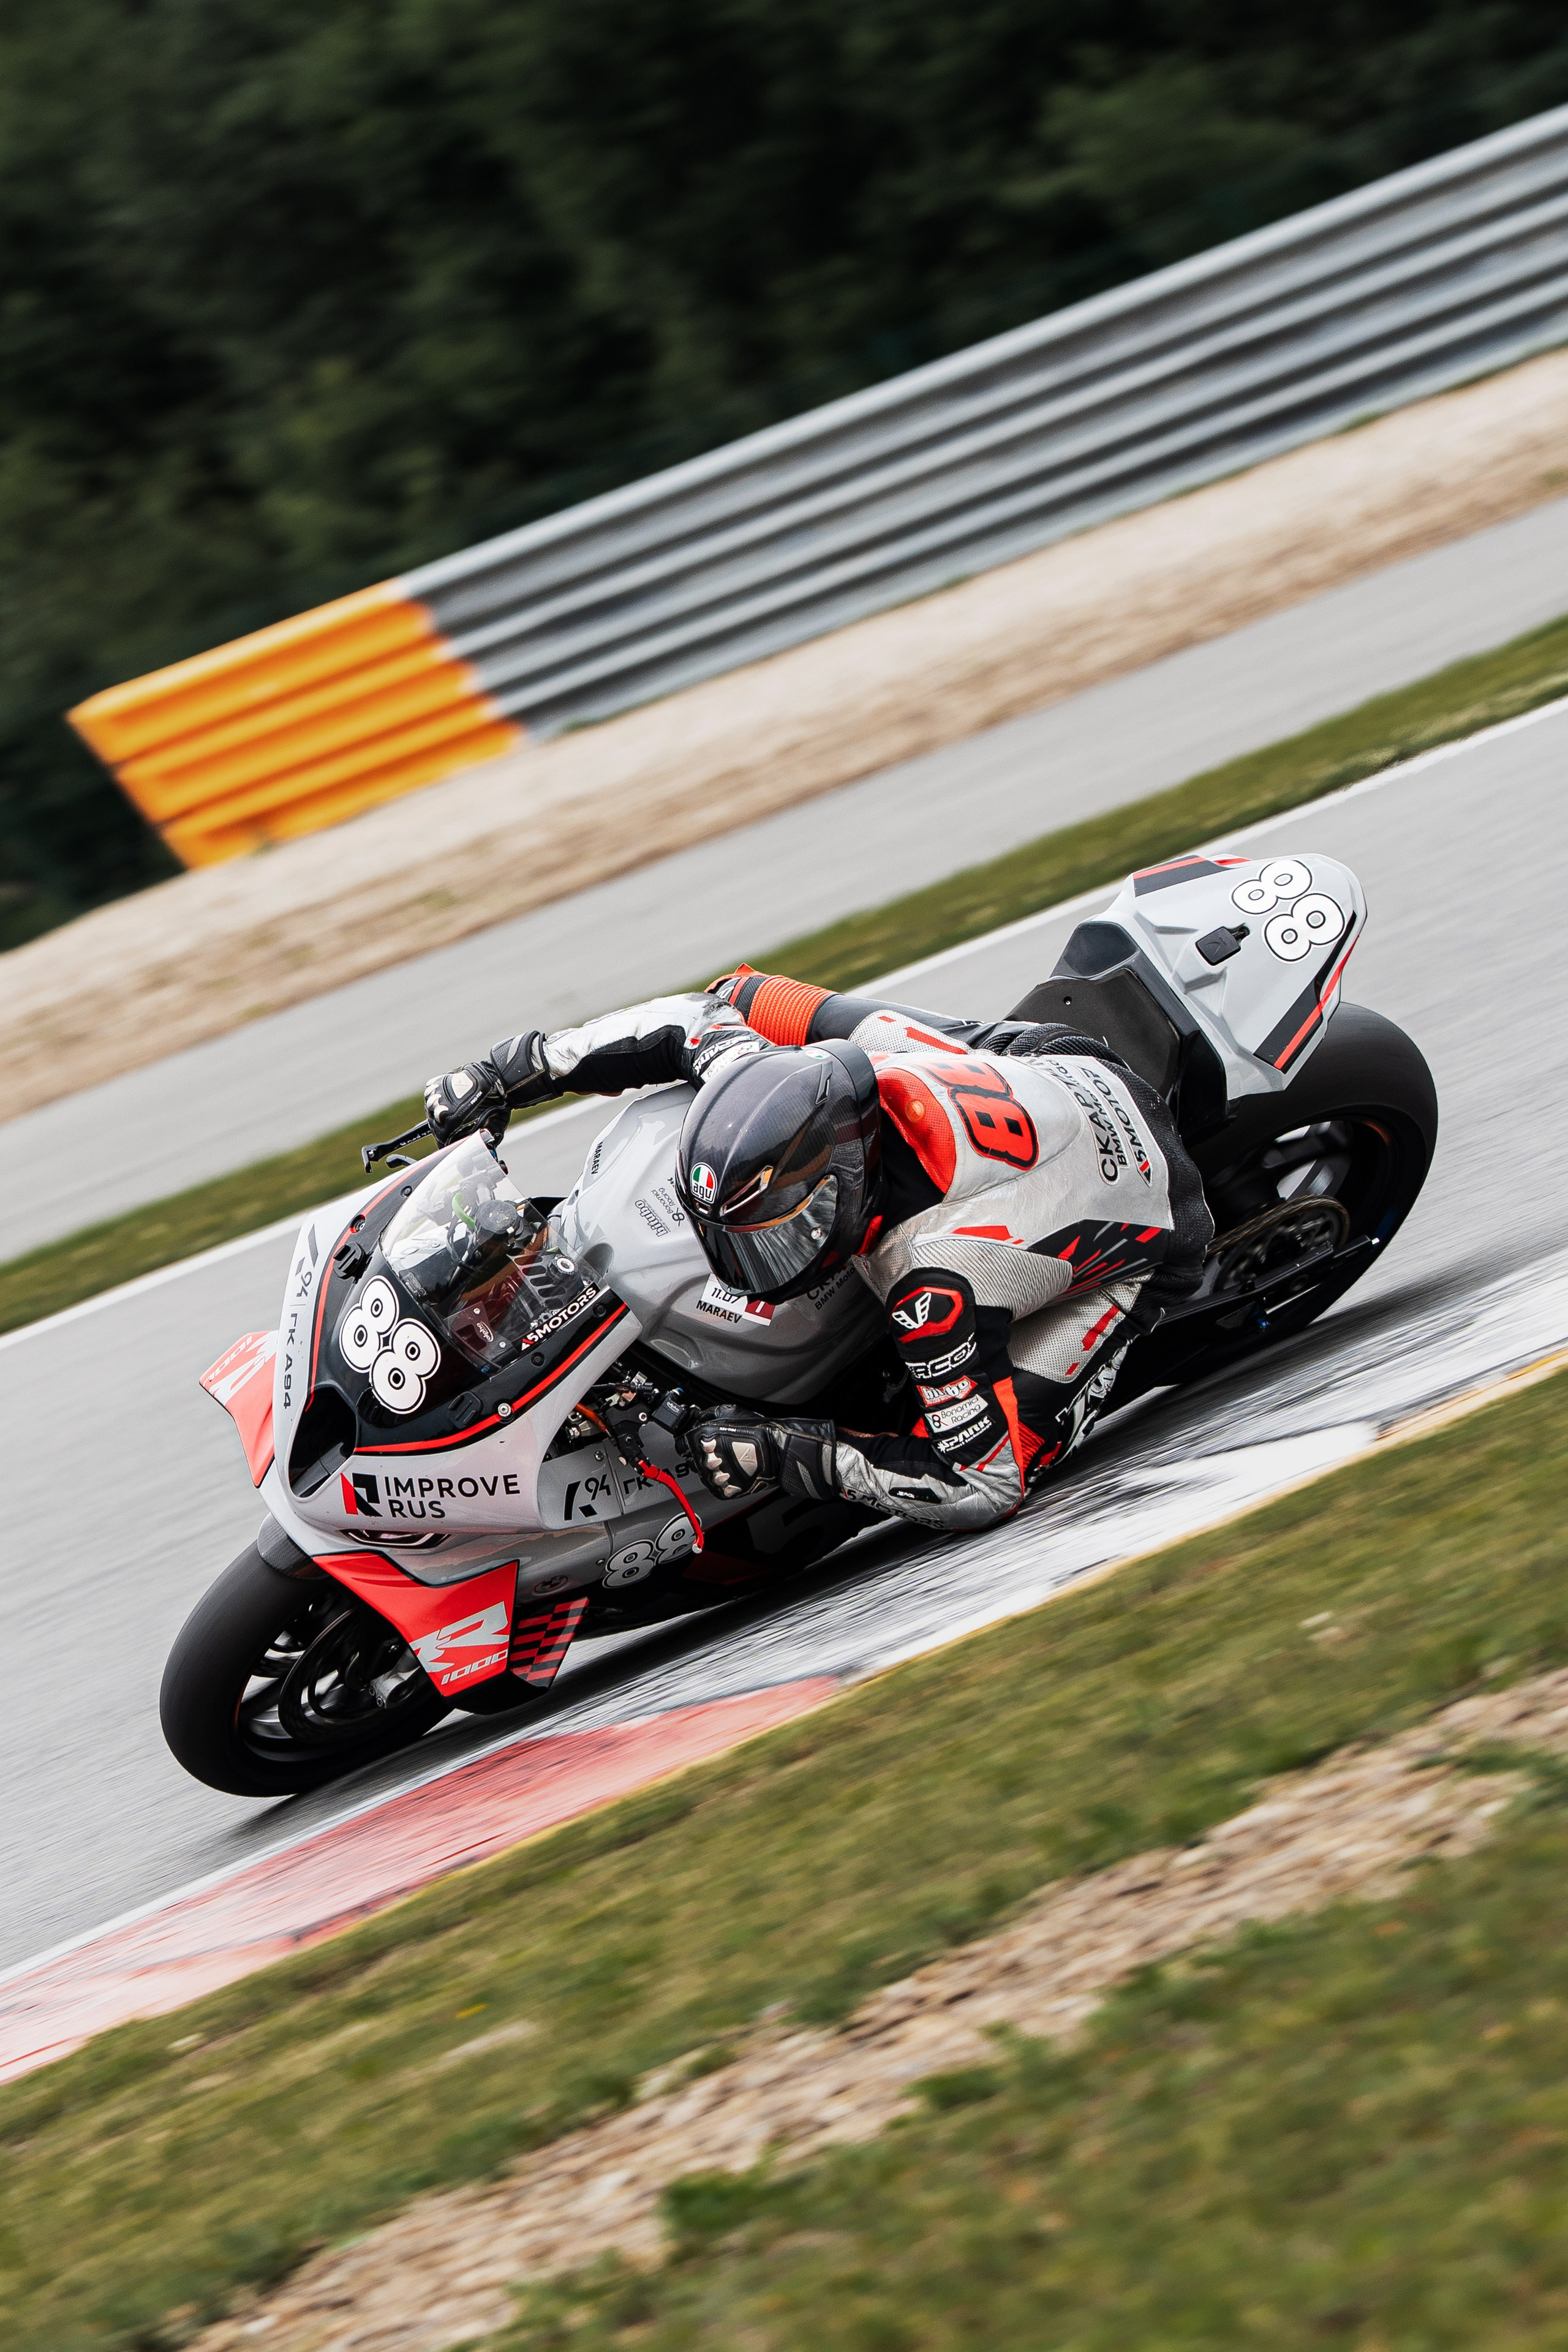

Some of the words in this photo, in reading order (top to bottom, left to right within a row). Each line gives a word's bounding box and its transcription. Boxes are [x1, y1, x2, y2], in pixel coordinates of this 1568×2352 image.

[1231, 859, 1346, 962] 88
[591, 1141, 603, 1175] MARAEV
[1104, 1120, 1128, 1166] BMW
[650, 1189, 674, 1214] Bonamici
[658, 1187, 676, 1207] Racing
[635, 1199, 668, 1237] bitubo
[815, 1286, 835, 1310] BMW
[835, 1267, 855, 1289] Moto
[696, 1300, 743, 1324] MARAEV
[339, 1274, 441, 1414] 88
[940, 1396, 979, 1419] Bonamici
[951, 1404, 981, 1424] Racing
[940, 1415, 990, 1449] SPARK
[384, 1473, 520, 1498] IMPROVE
[388, 1499, 446, 1519] RUS
[602, 1512, 703, 1589] 88
[440, 1648, 509, 1686] 1000
